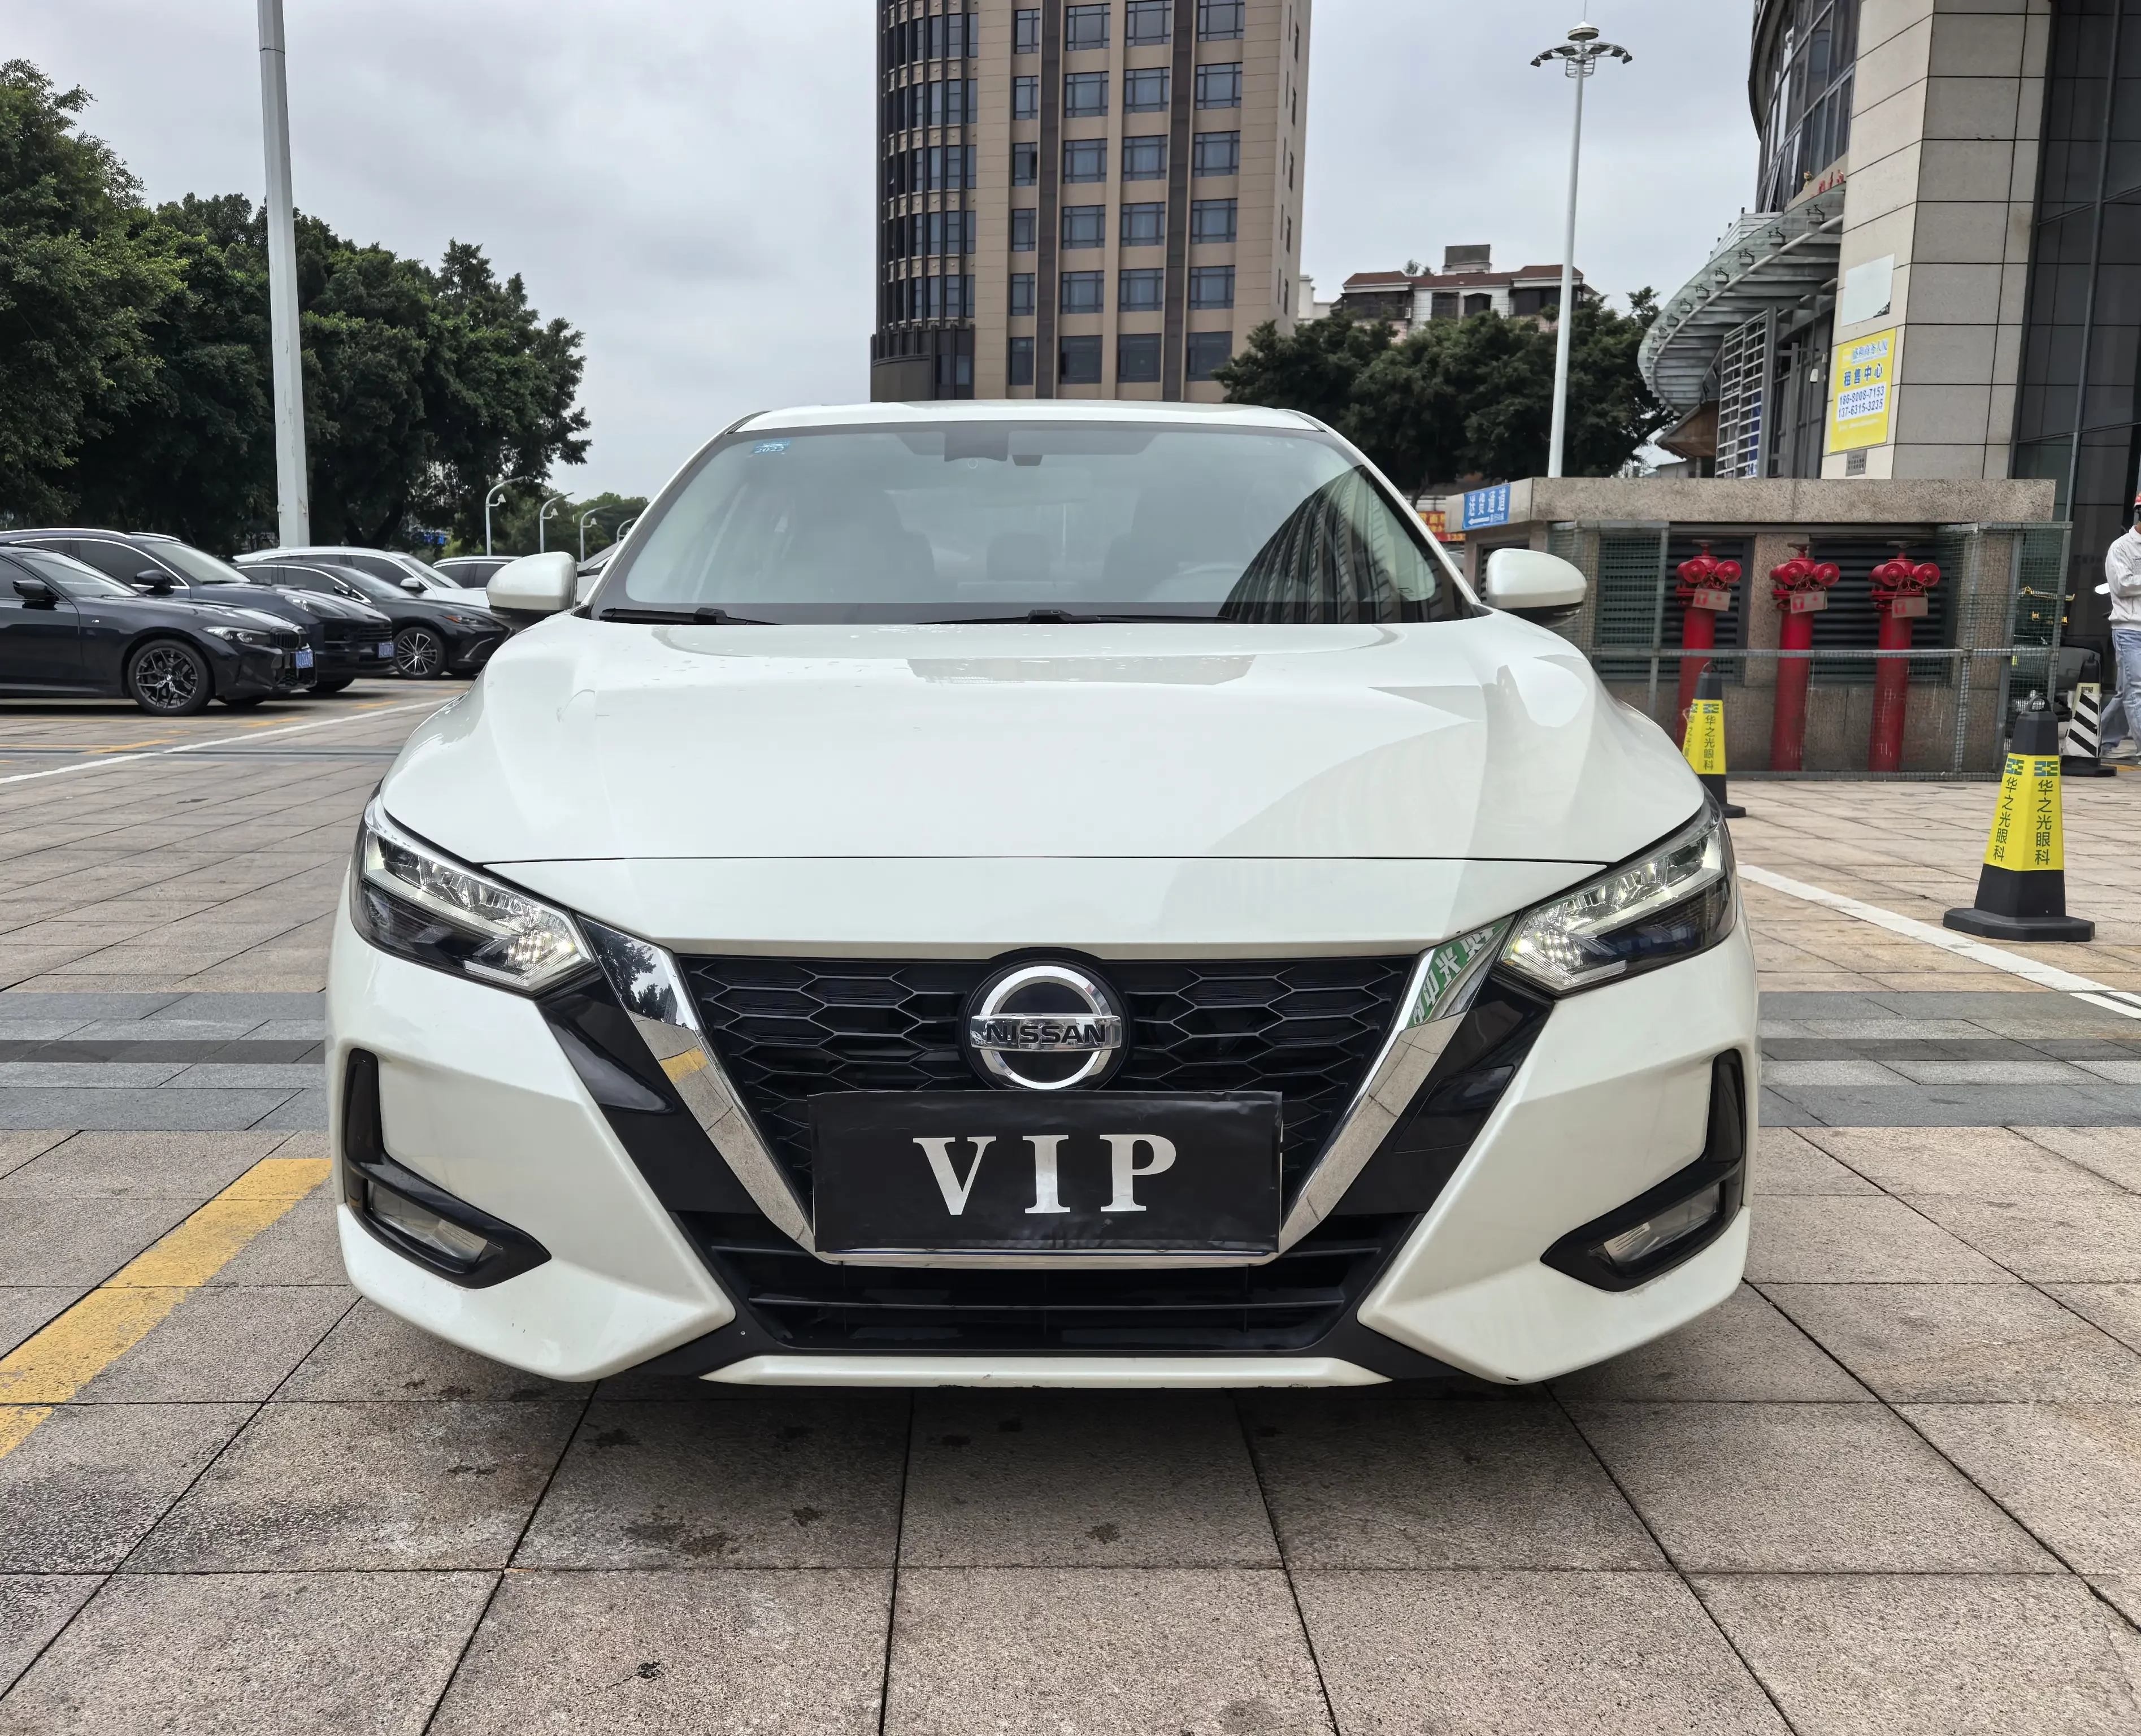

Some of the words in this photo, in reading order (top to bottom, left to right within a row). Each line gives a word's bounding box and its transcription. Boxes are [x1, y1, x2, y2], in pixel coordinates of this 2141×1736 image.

[1703, 714, 1716, 770] 华之光眼科
[1993, 776, 2018, 862] 华之光眼科
[2035, 779, 2053, 865] 华之光眼科
[987, 1024, 1106, 1044] NISSAN
[912, 1134, 1177, 1216] VIP
